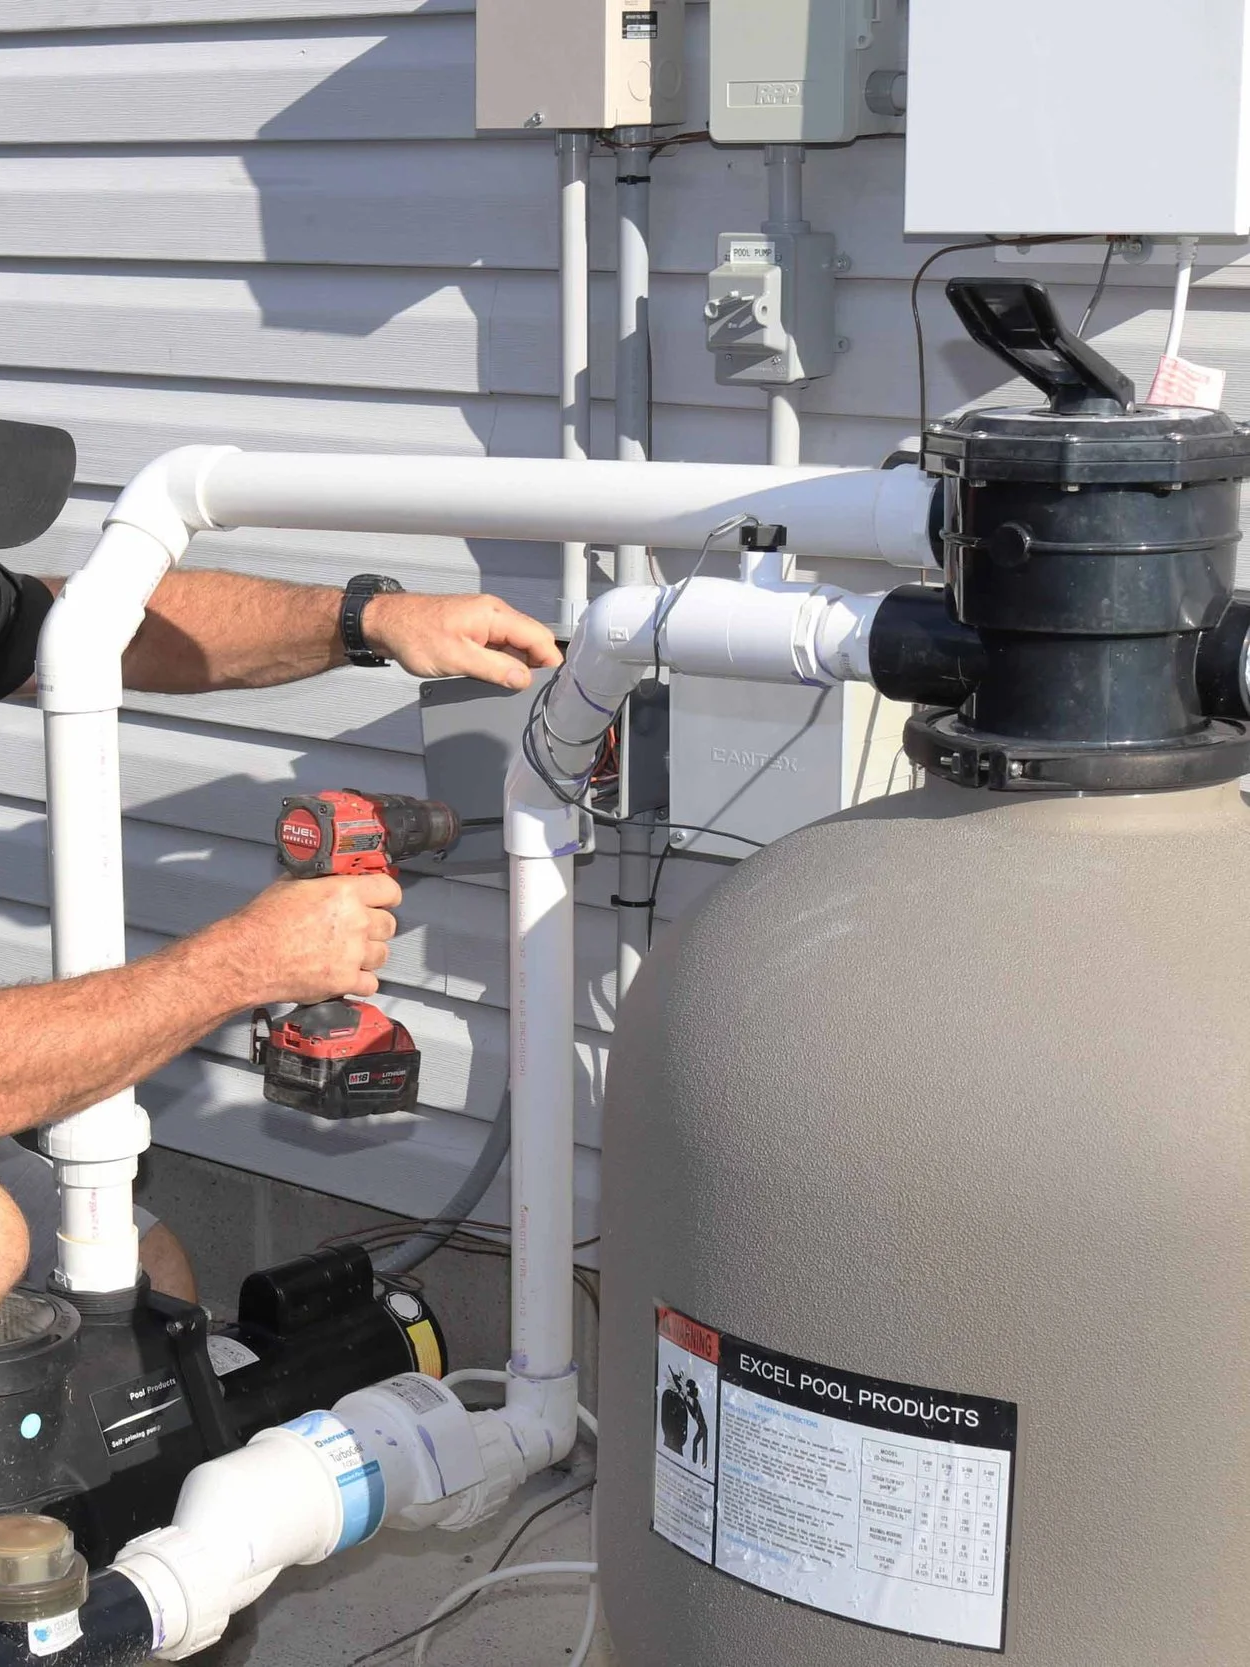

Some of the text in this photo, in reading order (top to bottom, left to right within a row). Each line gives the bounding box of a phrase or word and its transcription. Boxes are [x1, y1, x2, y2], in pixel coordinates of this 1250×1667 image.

[733, 248, 772, 257] POOL PUMP
[283, 824, 317, 838] FUEL
[350, 1073, 368, 1083] M18
[671, 1315, 712, 1357] WARNING
[129, 1378, 176, 1400] Pool Products
[740, 1353, 980, 1428] EXCEL POOL PRODUCTS
